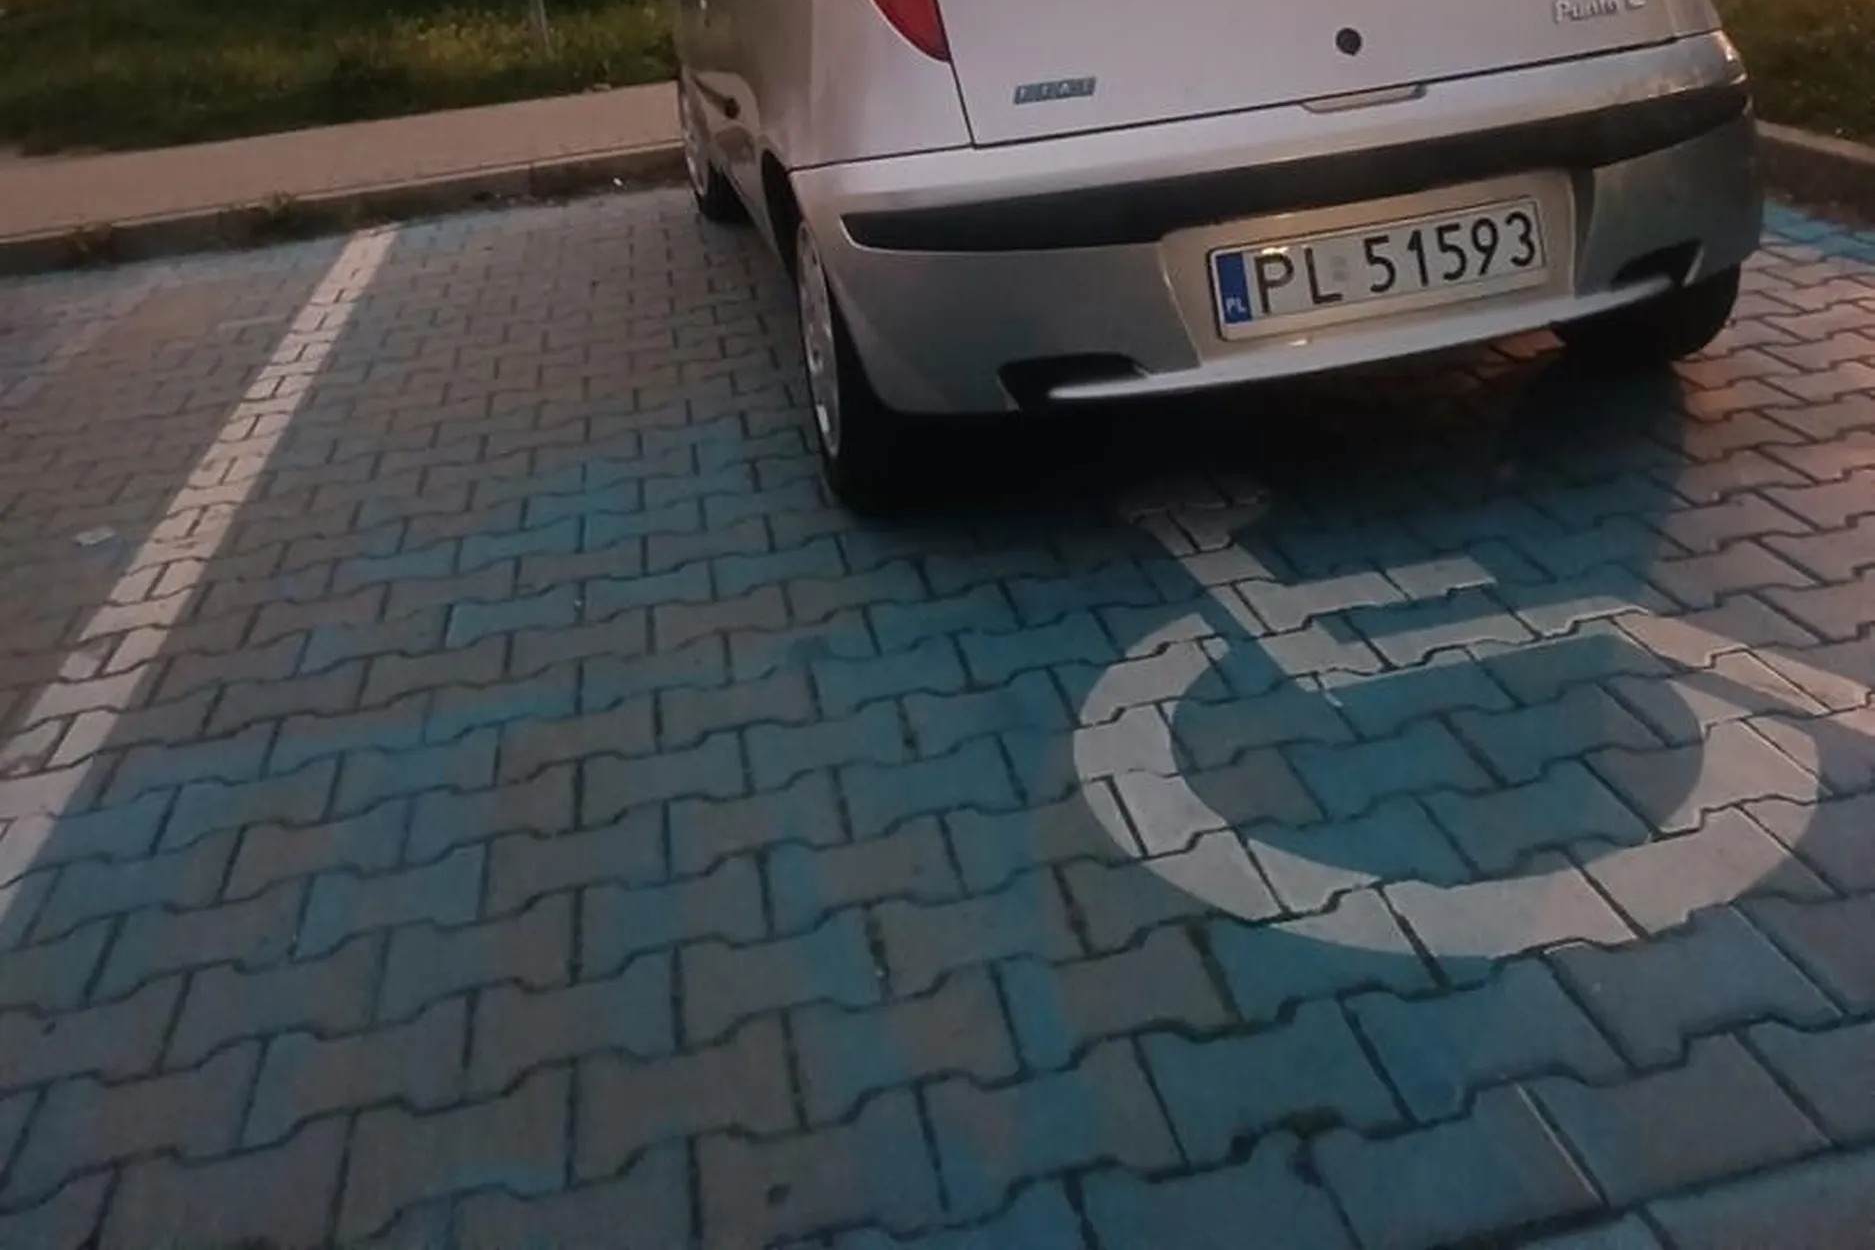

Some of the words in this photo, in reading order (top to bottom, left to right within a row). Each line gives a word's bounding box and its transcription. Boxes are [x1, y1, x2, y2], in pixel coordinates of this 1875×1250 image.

[1254, 247, 1344, 315] PL
[1362, 210, 1538, 294] 51593
[1226, 297, 1247, 314] PL
